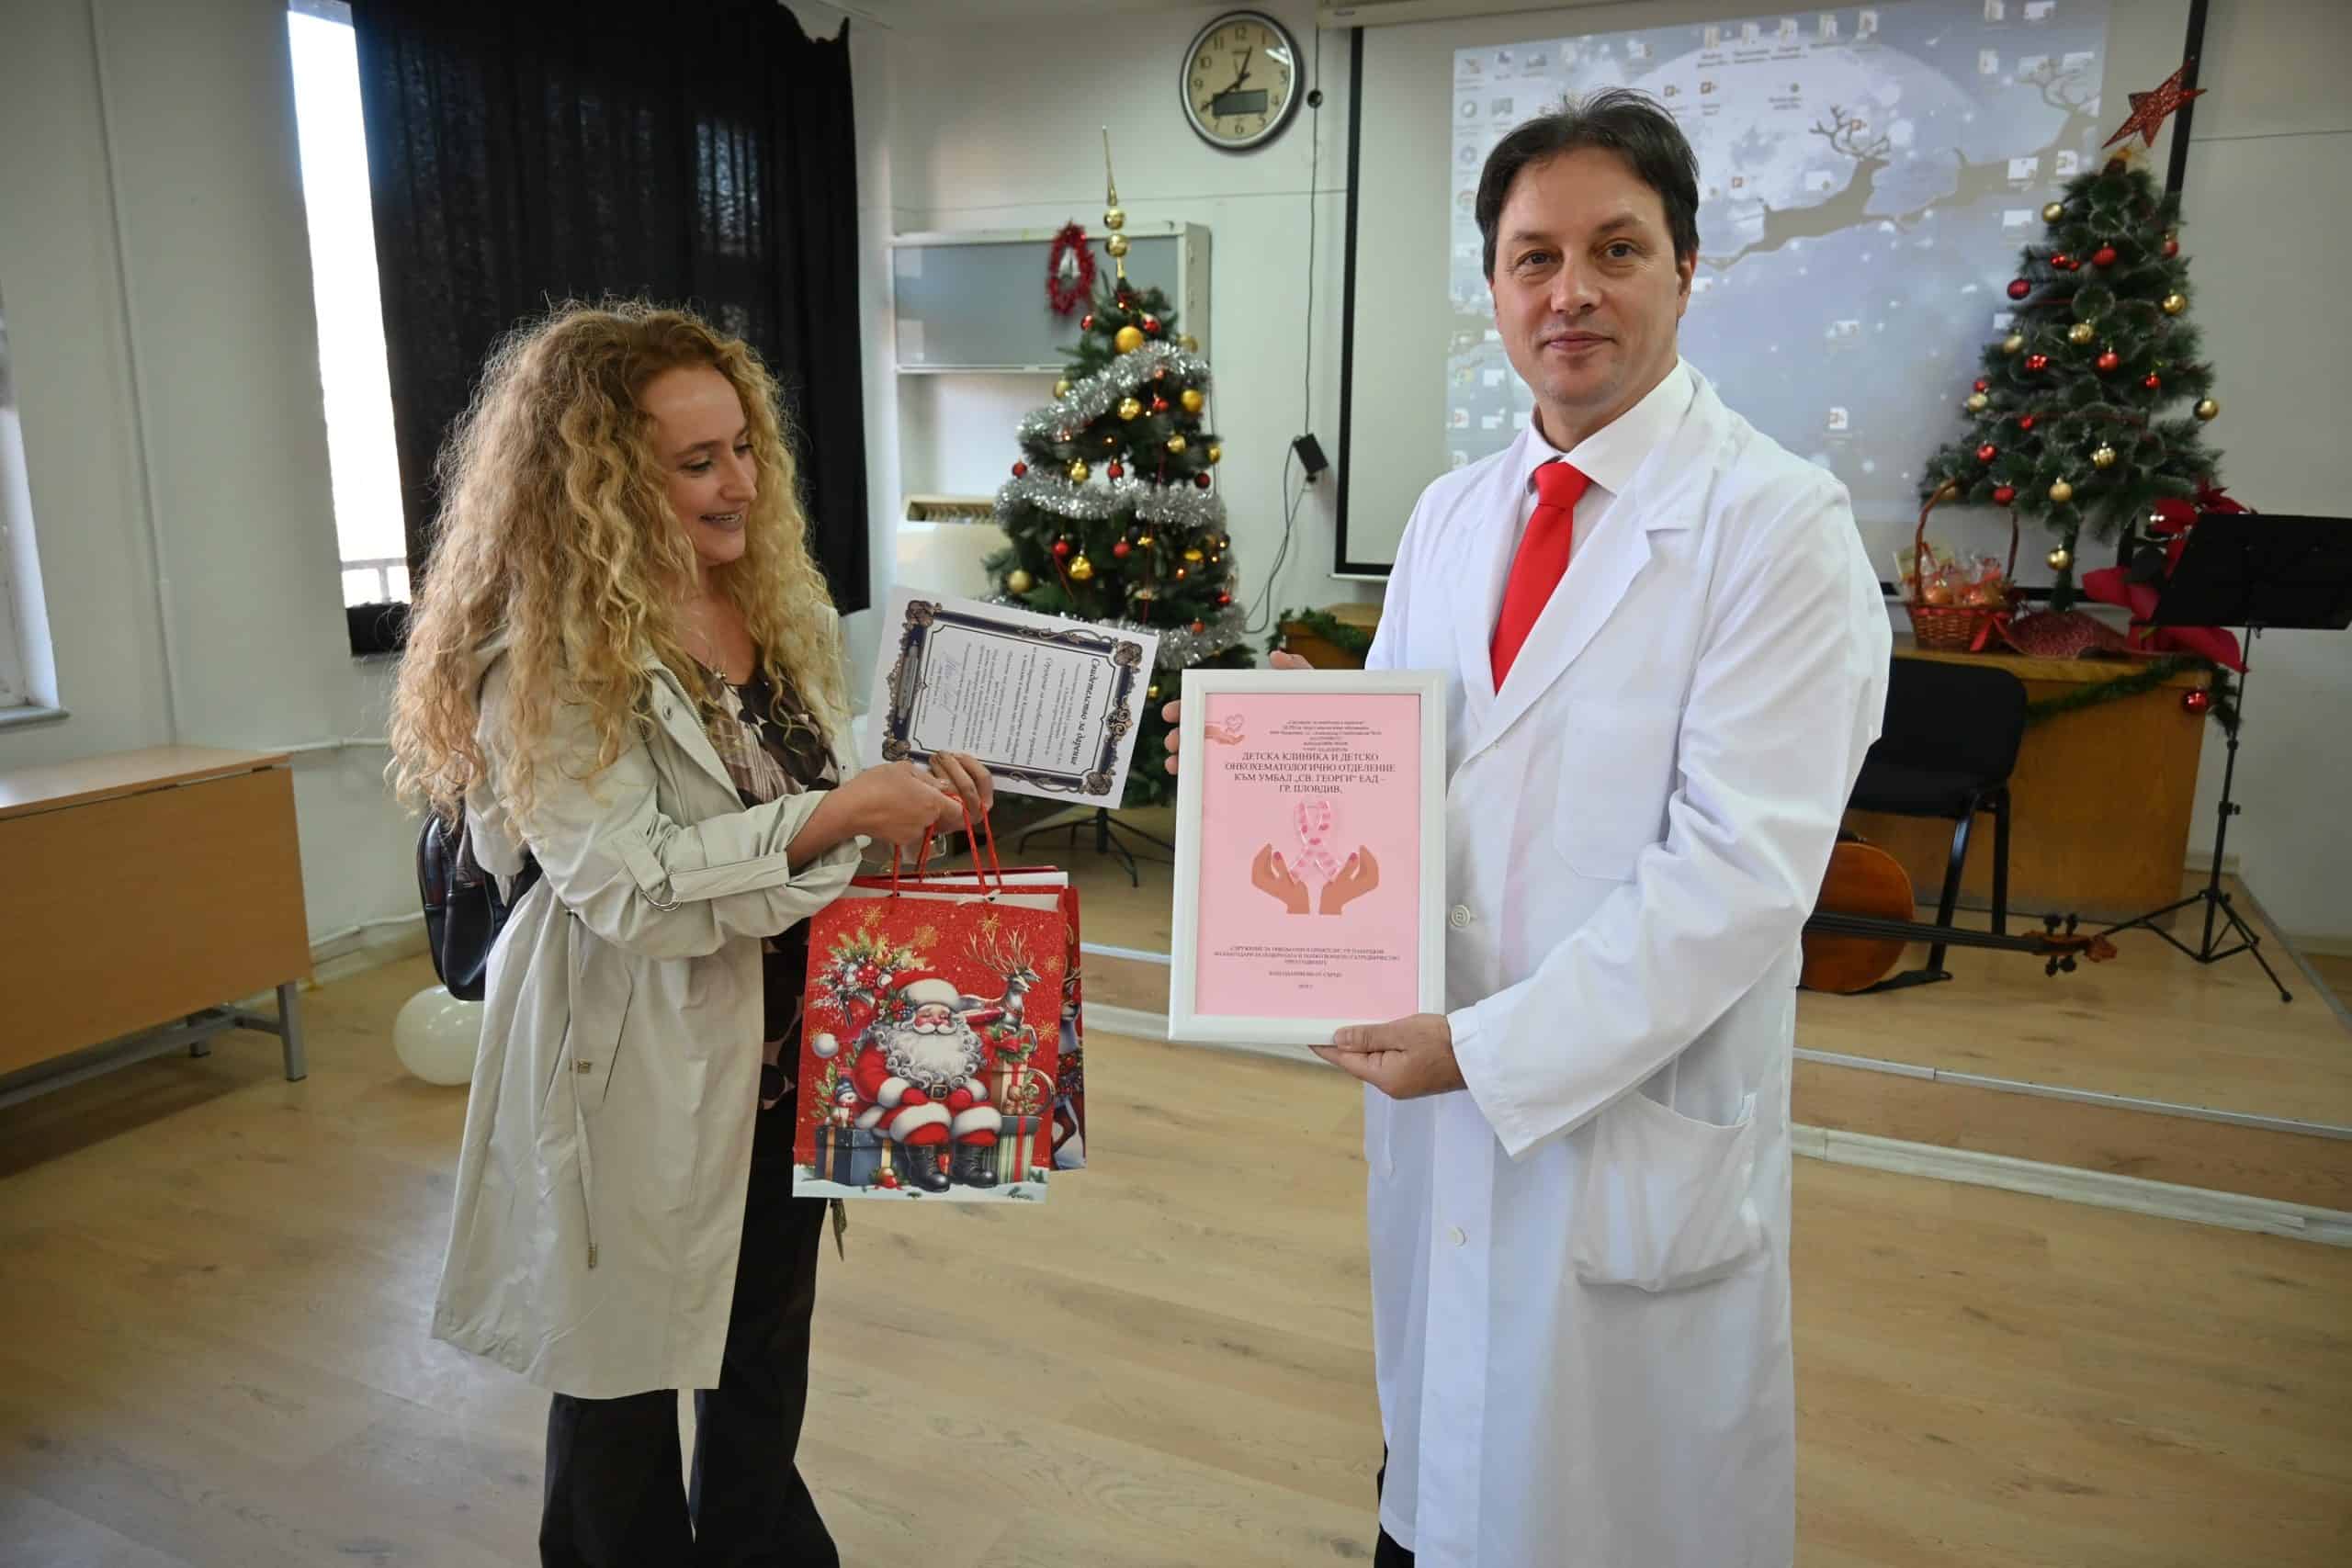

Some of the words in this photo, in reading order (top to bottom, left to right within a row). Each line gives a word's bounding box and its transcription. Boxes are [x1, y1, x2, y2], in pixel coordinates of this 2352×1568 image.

[1235, 25, 1247, 39] 12
[1214, 35, 1225, 51] 11
[1199, 56, 1212, 69] 10
[1193, 79, 1204, 91] 9
[1272, 95, 1280, 107] 4
[1257, 114, 1267, 127] 5
[1235, 124, 1244, 134] 6
[1070, 732, 1086, 765] дарение
[1242, 752, 1280, 761] ДЕТСКА
[1282, 752, 1329, 761] КЛИНИКА
[1331, 753, 1339, 761] И
[1340, 753, 1379, 762] ДЕТСКО
[1225, 761, 1338, 772] ОНКОХЕМАТОЛОГИЧНО
[1338, 762, 1396, 773] ОТДЕЛЕНИЕ
[1234, 773, 1257, 782] КЪМ
[1258, 773, 1293, 782] УМБАЛ
[1359, 774, 1379, 784] ЕАД
